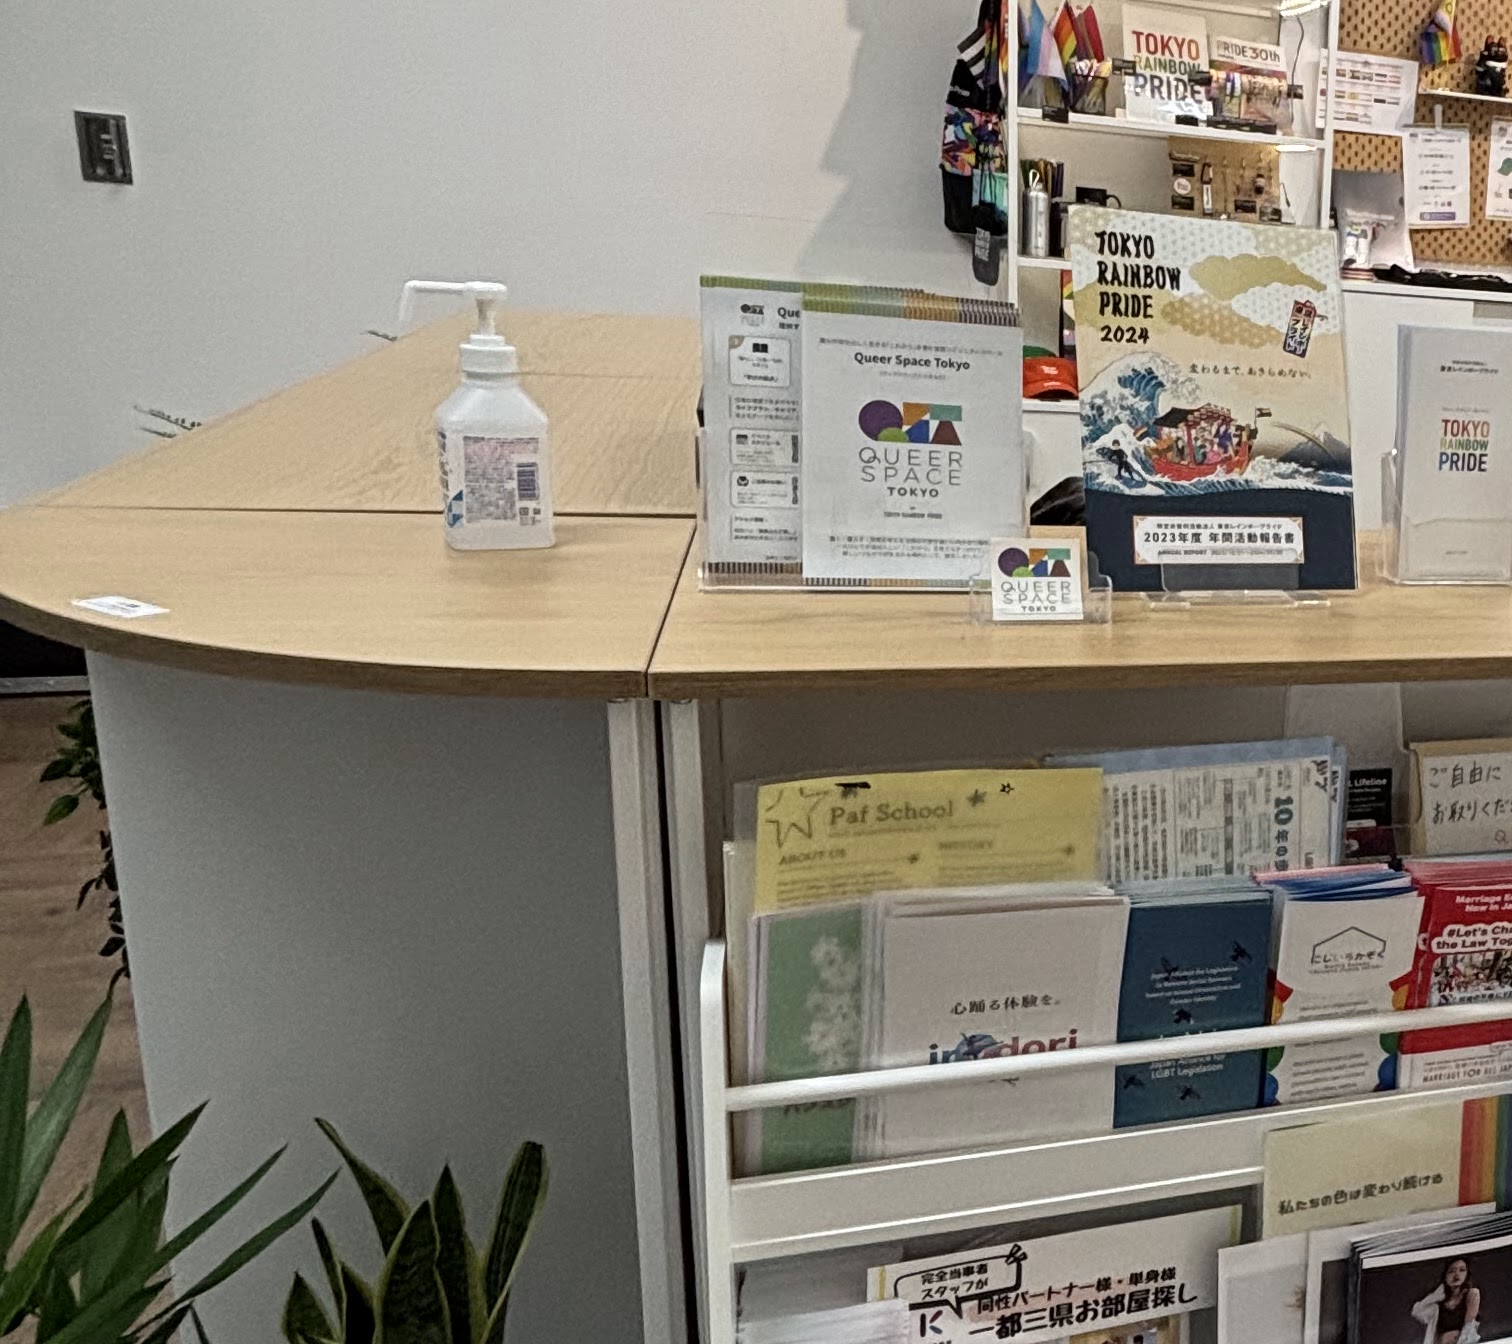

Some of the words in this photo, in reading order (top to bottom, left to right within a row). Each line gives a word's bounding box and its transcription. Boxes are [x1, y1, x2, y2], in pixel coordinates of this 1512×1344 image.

[1132, 30, 1200, 61] TOKYO
[1134, 54, 1201, 77] RAINBOW
[1134, 74, 1204, 105] PRIDE
[1094, 230, 1155, 259] TOKYO
[1097, 261, 1181, 291] RAINBOW
[1099, 291, 1153, 319] PRIDE
[1101, 325, 1150, 344] 2024
[854, 352, 892, 364] Queer
[895, 354, 932, 368] Space
[934, 357, 970, 372] Tokyo
[1442, 419, 1490, 438] TOKYO
[1440, 438, 1489, 452] RAINBOW
[859, 447, 963, 468] QUEER
[1439, 452, 1488, 472] PRIDE
[861, 465, 961, 486] SPACE
[887, 487, 939, 497] TOKYO
[1144, 532, 1202, 544] 2023年度
[1208, 532, 1294, 544] 年間活動報告書
[1001, 581, 1071, 593] QUEER
[1003, 593, 1071, 605] SPACE
[1430, 761, 1502, 788] ご自由に
[875, 800, 954, 824] School
[1456, 894, 1501, 905] Marriage
[1489, 902, 1499, 910] in
[1447, 928, 1488, 938] #Let's
[1436, 939, 1457, 950] the
[1462, 937, 1487, 948] Law
[1151, 1067, 1176, 1079] LGBT
[1178, 1064, 1223, 1077] Legislation
[1463, 1067, 1481, 1078] FOR
[1278, 1173, 1443, 1216] 私たちの色は変わり続ける
[921, 1263, 988, 1285] 完全当事者
[921, 1278, 988, 1300] スタッフが
[976, 1266, 1177, 1315] 同性パートナー様・単身様
[969, 1283, 1198, 1339] 一都三県お部屋探し
